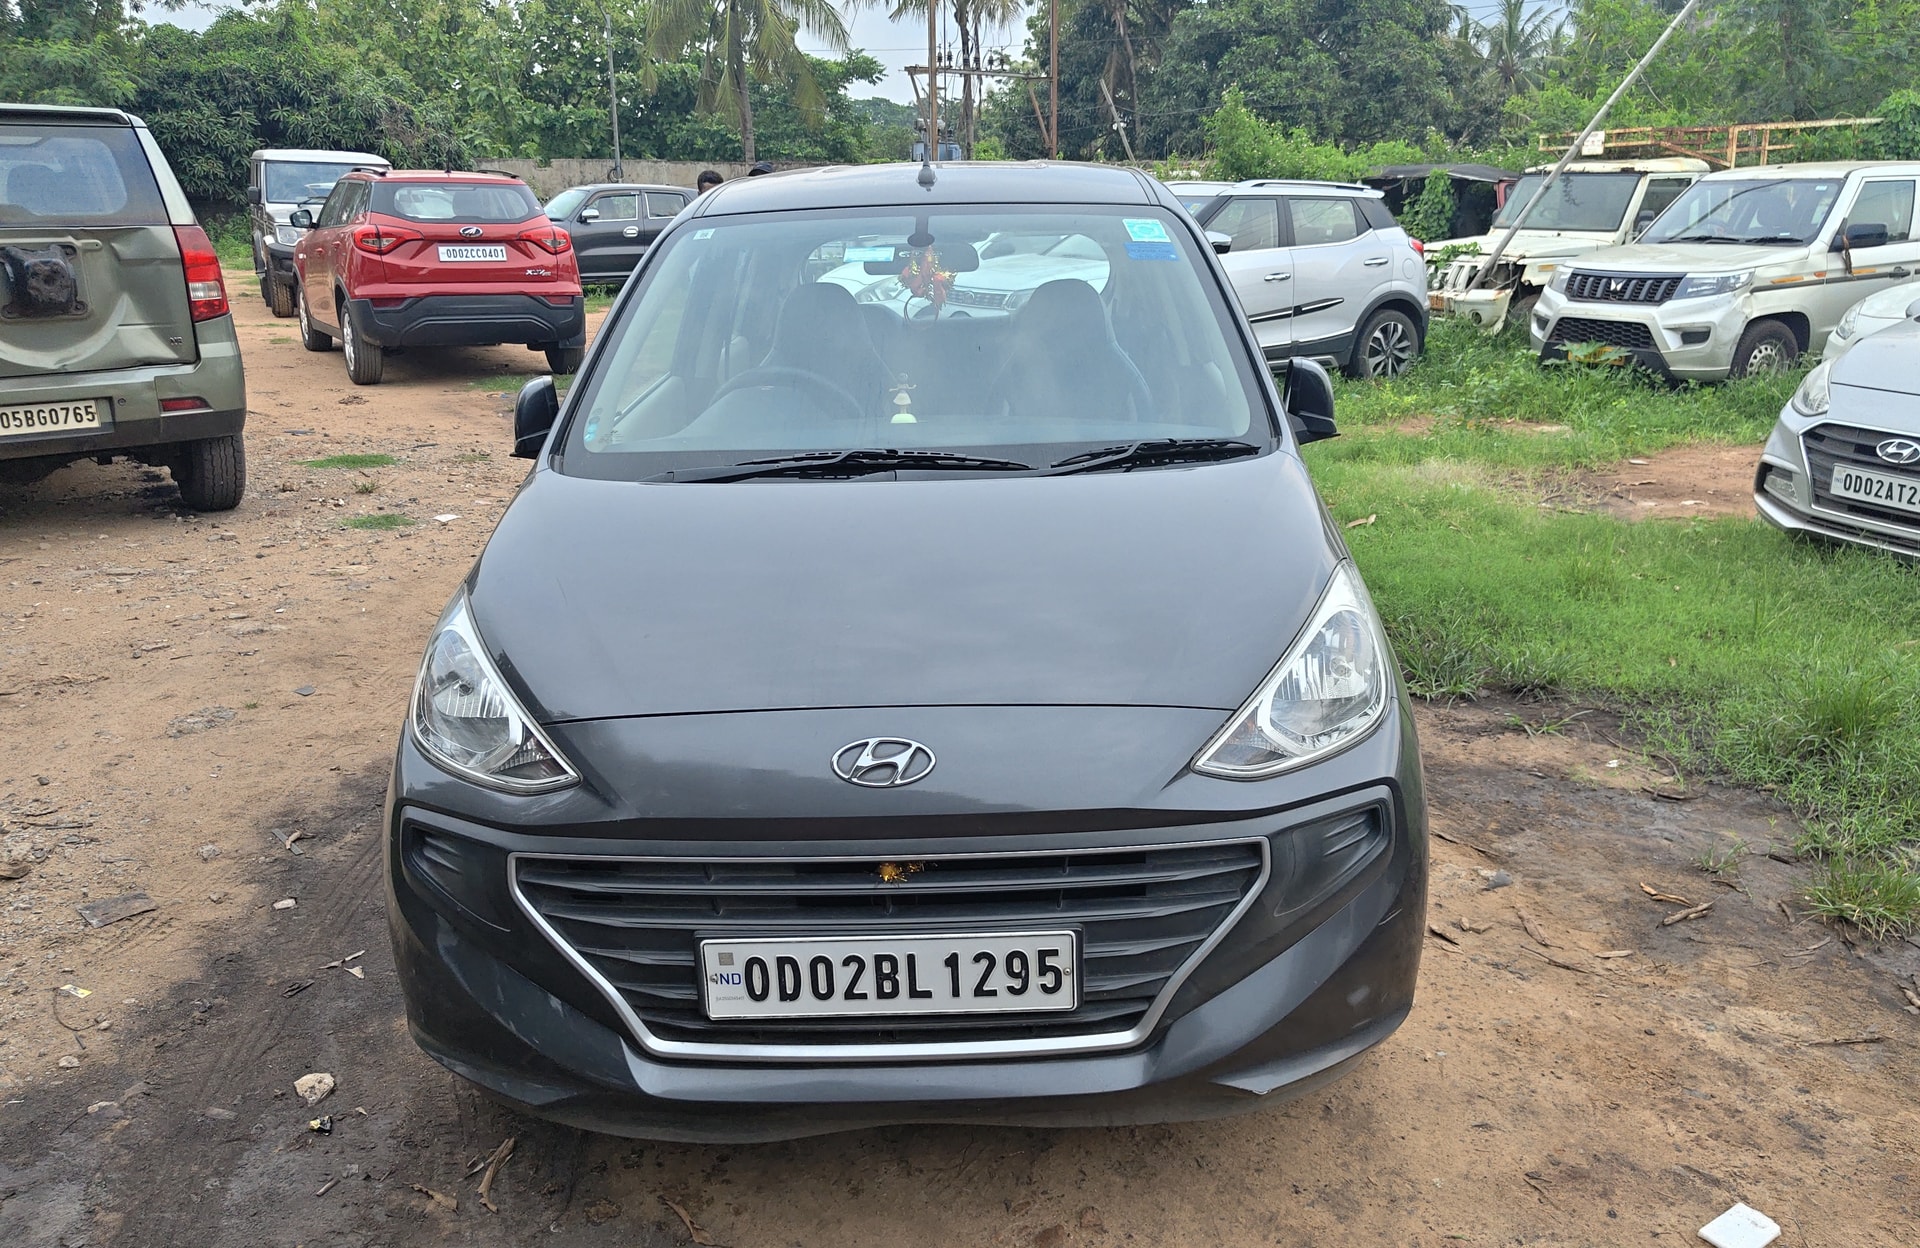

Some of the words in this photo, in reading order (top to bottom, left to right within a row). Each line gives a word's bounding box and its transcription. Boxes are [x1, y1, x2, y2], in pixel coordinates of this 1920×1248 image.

[446, 248, 505, 259] OD02CC0401
[0, 404, 97, 429] 05BG0765
[1843, 473, 1920, 506] OD02AT2
